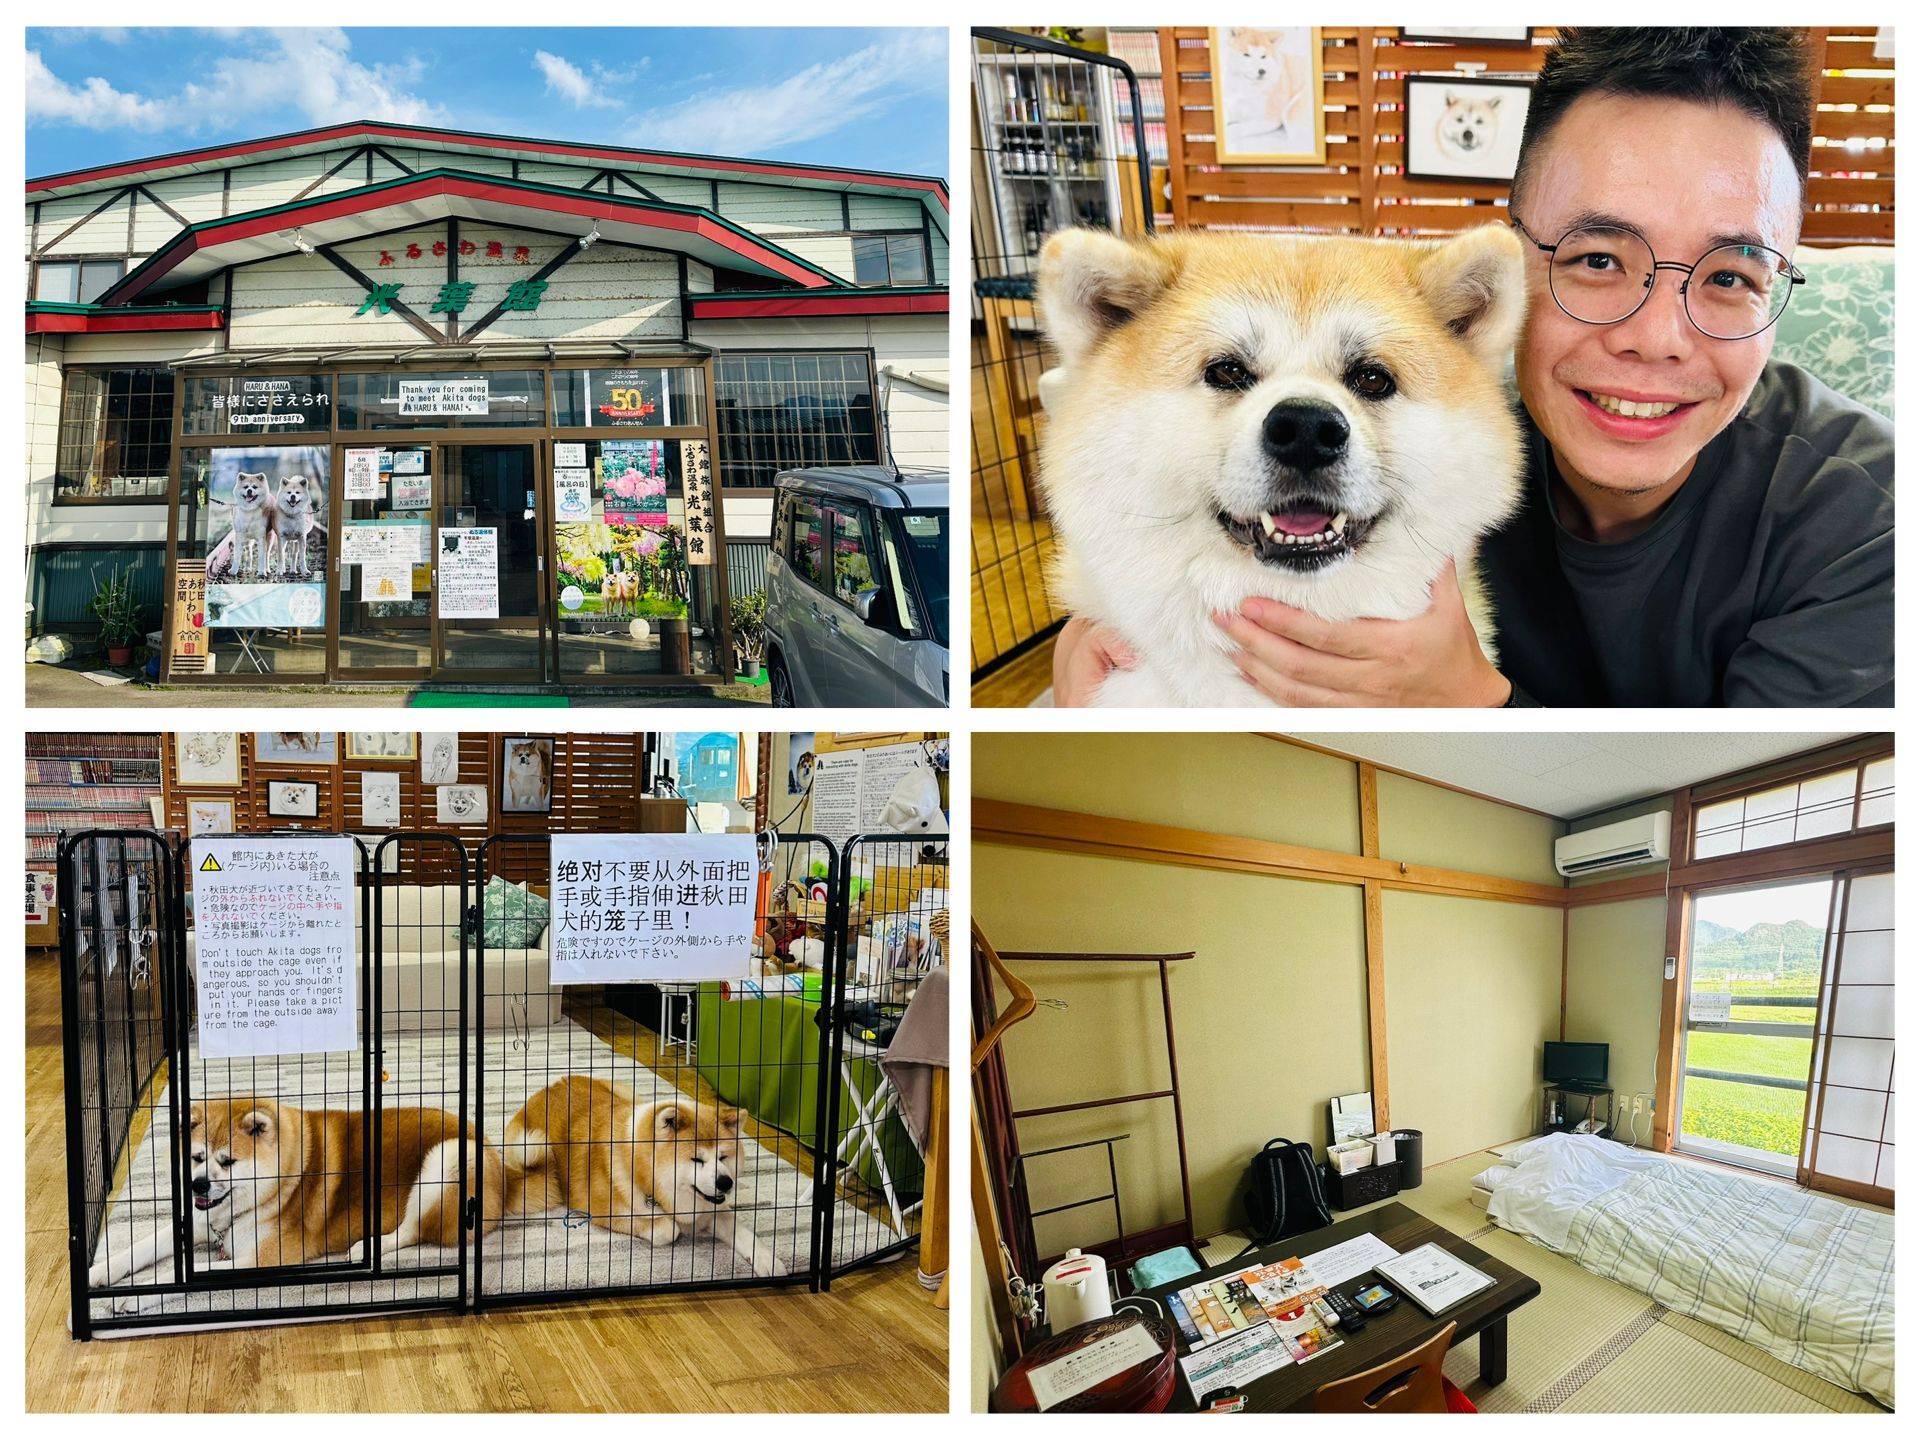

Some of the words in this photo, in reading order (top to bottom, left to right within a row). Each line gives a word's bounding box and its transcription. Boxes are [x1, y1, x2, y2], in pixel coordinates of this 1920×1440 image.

[379, 239, 530, 266] ふるさわ温泉
[246, 383, 263, 391] HARU
[271, 382, 289, 390] HANA
[460, 385, 486, 394] coming
[212, 393, 330, 409] 皆様にささえられ
[469, 394, 486, 402] dogs
[612, 388, 642, 411] 50
[414, 404, 431, 412] HARU
[253, 415, 303, 424] anniversary.
[685, 444, 698, 492] ふるさわ温泉
[698, 443, 714, 533] 大館旅館組合
[687, 495, 704, 554] 光葉館
[177, 579, 187, 602] 空間
[186, 579, 197, 621] あじわい
[232, 851, 318, 861] 館内にあきた犬が
[309, 871, 340, 881] 注意点
[557, 859, 750, 882] 绝对不要从外面把
[25, 872, 36, 914] 食事会場
[558, 884, 747, 907] 手或手指伸进秋田
[558, 909, 690, 932] 犬的笼子里！
[557, 934, 746, 948] 危険ですのでケージの外側から手や
[236, 949, 262, 957] touch
[268, 948, 294, 956] Akita
[300, 947, 321, 956] dogs
[327, 946, 342, 954] fro
[556, 947, 679, 961] 指は入れないで下さい。
[213, 958, 252, 967] outside
[279, 959, 300, 967] cage
[306, 957, 326, 965] even
[209, 969, 230, 979] they
[236, 968, 279, 978] approach
[285, 969, 303, 977] you.
[337, 966, 342, 974] d
[275, 979, 290, 987] you
[209, 991, 224, 999] put
[231, 989, 251, 998] your
[258, 988, 285, 996] hands
[307, 986, 342, 995] fingers
[211, 1001, 221, 1009] in
[227, 1000, 240, 1008] it.
[247, 998, 280, 1007] Please
[286, 997, 306, 1006] take
[322, 996, 342, 1005] pict
[204, 1011, 221, 1019] ure
[227, 1009, 248, 1017] from
[254, 1009, 270, 1017] the
[275, 1007, 312, 1016] outside
[317, 1007, 338, 1015] away
[205, 1020, 227, 1029] from
[233, 1020, 248, 1028] the
[254, 1020, 278, 1028] cage.
